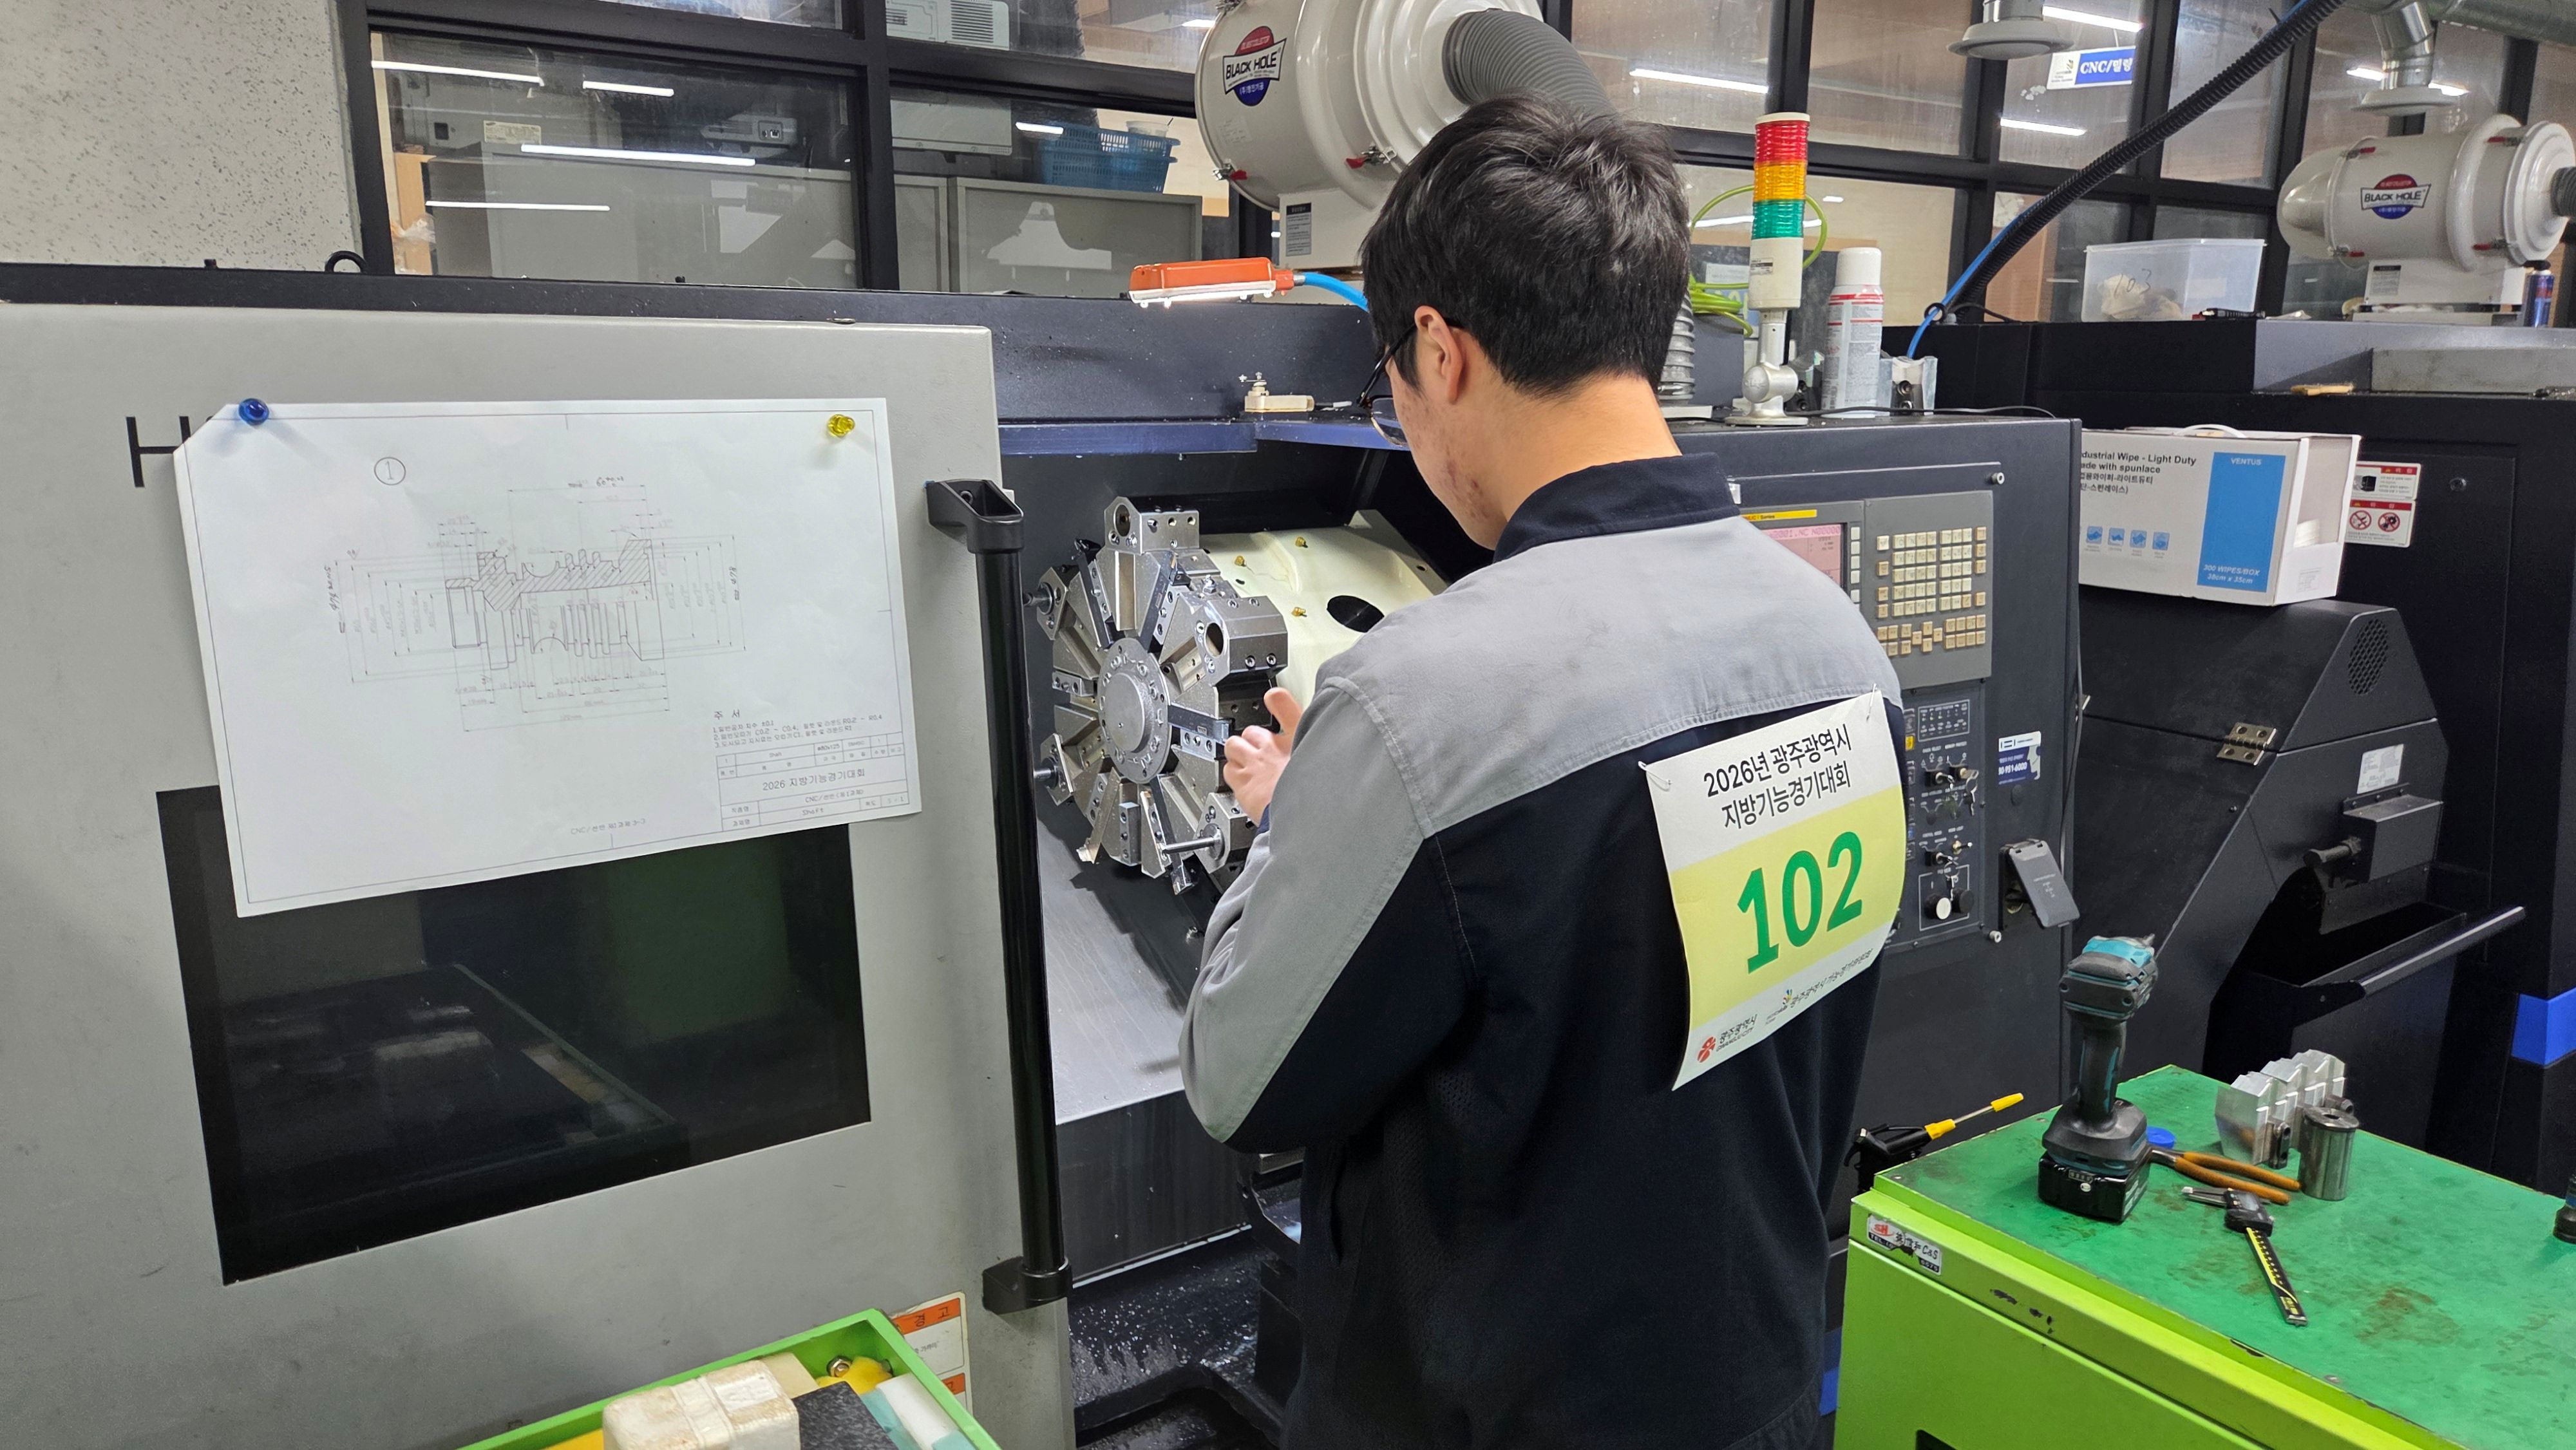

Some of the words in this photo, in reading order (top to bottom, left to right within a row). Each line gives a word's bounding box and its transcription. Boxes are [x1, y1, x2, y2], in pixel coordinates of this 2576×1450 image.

[1226, 61, 1252, 80] BLACK
[1254, 52, 1278, 70] HOLE
[2080, 58, 2133, 74] CNC/밀링
[2364, 193, 2393, 203] BLACK
[2396, 191, 2421, 200] HOLE
[2114, 268, 2152, 299] 103
[2081, 451, 2115, 460] dustrial
[2117, 452, 2139, 462] Wipe
[2148, 455, 2171, 465] Light
[2174, 456, 2197, 467] Duty
[2099, 462, 2117, 471] with
[2119, 465, 2161, 474] spunlace
[2218, 565, 2260, 576] WIPES/BOX
[714, 711, 723, 720] 주
[732, 709, 739, 718] 서
[1703, 751, 1770, 797] 2026년
[1772, 724, 1852, 771] 광주광역시
[762, 781, 786, 791] 2026
[789, 768, 866, 787] 지방기능경기대회
[1721, 760, 1852, 829] 지방기능경기대회
[1738, 831, 1862, 975] 102
[1922, 1245, 1938, 1259] C&S
